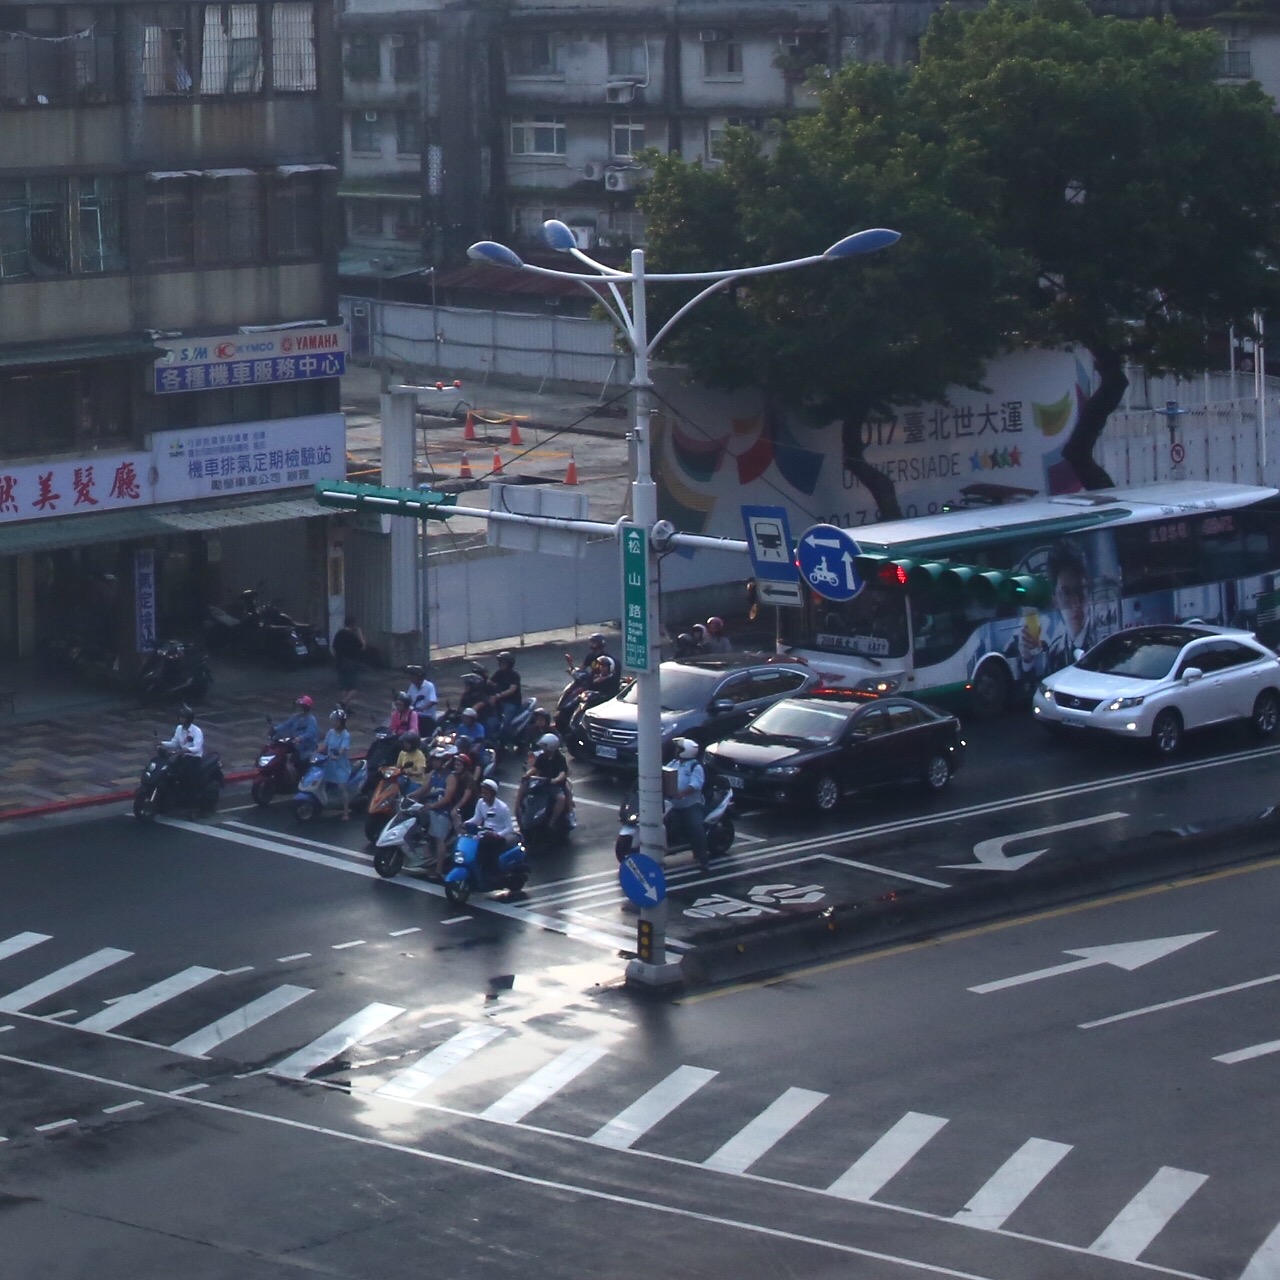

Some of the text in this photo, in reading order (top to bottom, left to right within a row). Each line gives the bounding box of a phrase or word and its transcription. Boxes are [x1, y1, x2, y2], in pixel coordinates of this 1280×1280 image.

[296, 334, 338, 351] YAMAHA
[161, 354, 340, 391] 各種機車服務中心
[903, 401, 1023, 445] 臺北世大運
[187, 445, 332, 480] 機車排氣定期檢驗站
[842, 453, 961, 490] UERSIADE
[627, 539, 641, 619] 松山路
